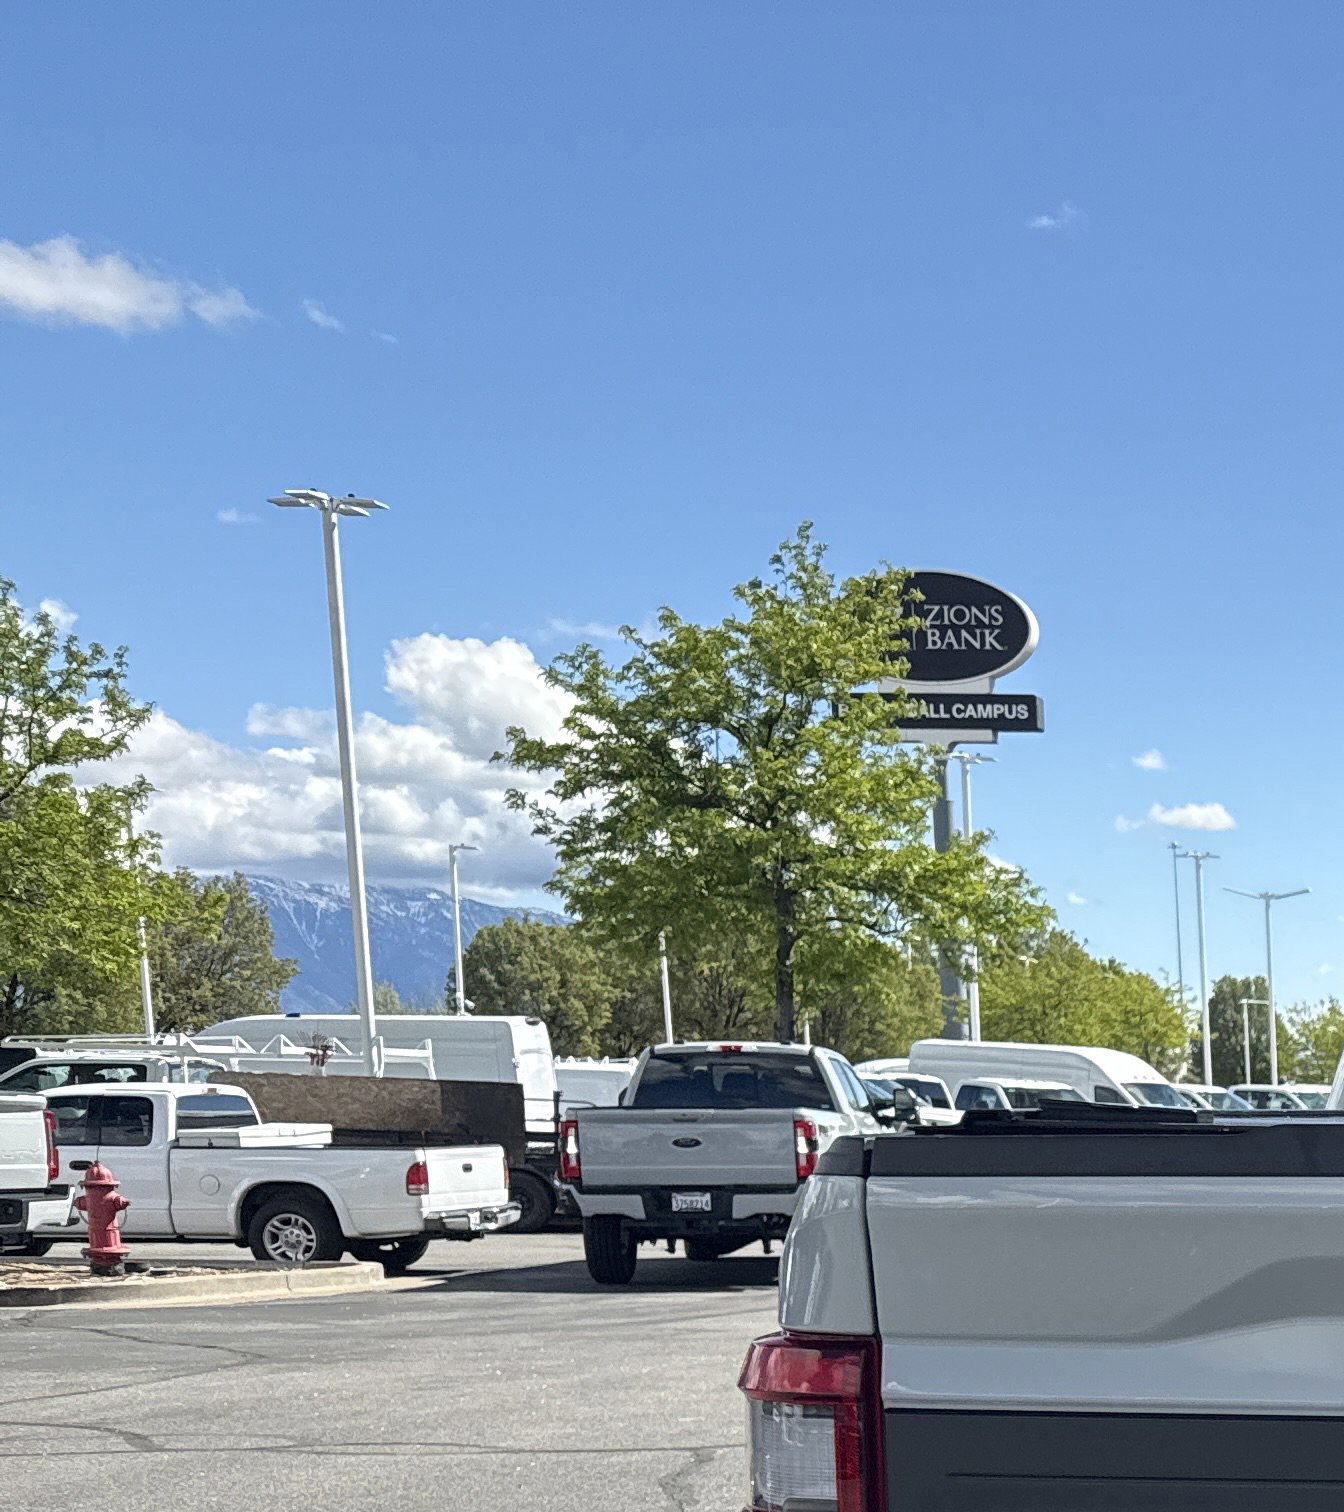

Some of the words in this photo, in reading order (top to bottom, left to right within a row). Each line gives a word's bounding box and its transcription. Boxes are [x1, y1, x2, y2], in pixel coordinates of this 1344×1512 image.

[923, 604, 1004, 626] ZIONS
[924, 628, 1004, 650] BANK
[952, 704, 1029, 719] CAMPUS
